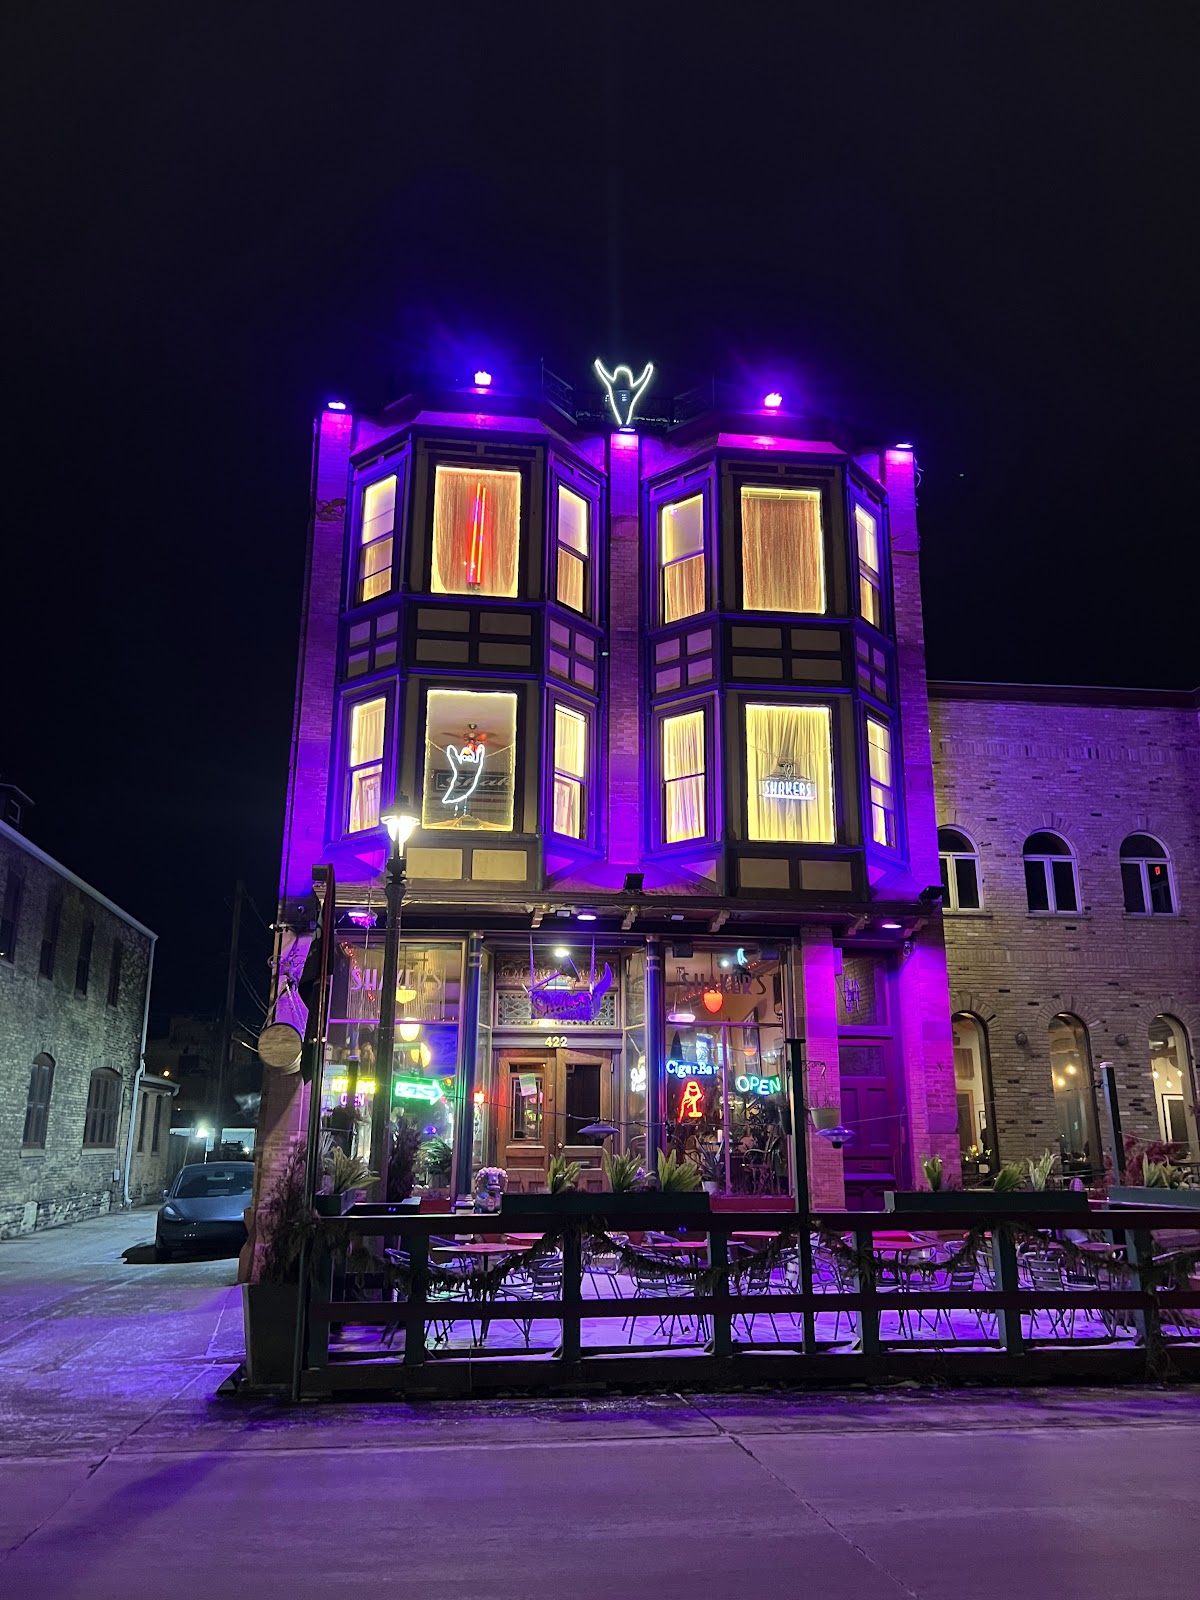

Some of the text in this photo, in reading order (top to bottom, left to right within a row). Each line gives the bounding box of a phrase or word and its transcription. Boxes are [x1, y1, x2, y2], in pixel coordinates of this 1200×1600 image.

[764, 780, 812, 797] SHAKERS
[544, 1036, 568, 1048] 422
[666, 1060, 720, 1078] Cigar Bar
[737, 1075, 781, 1095] OPEN
